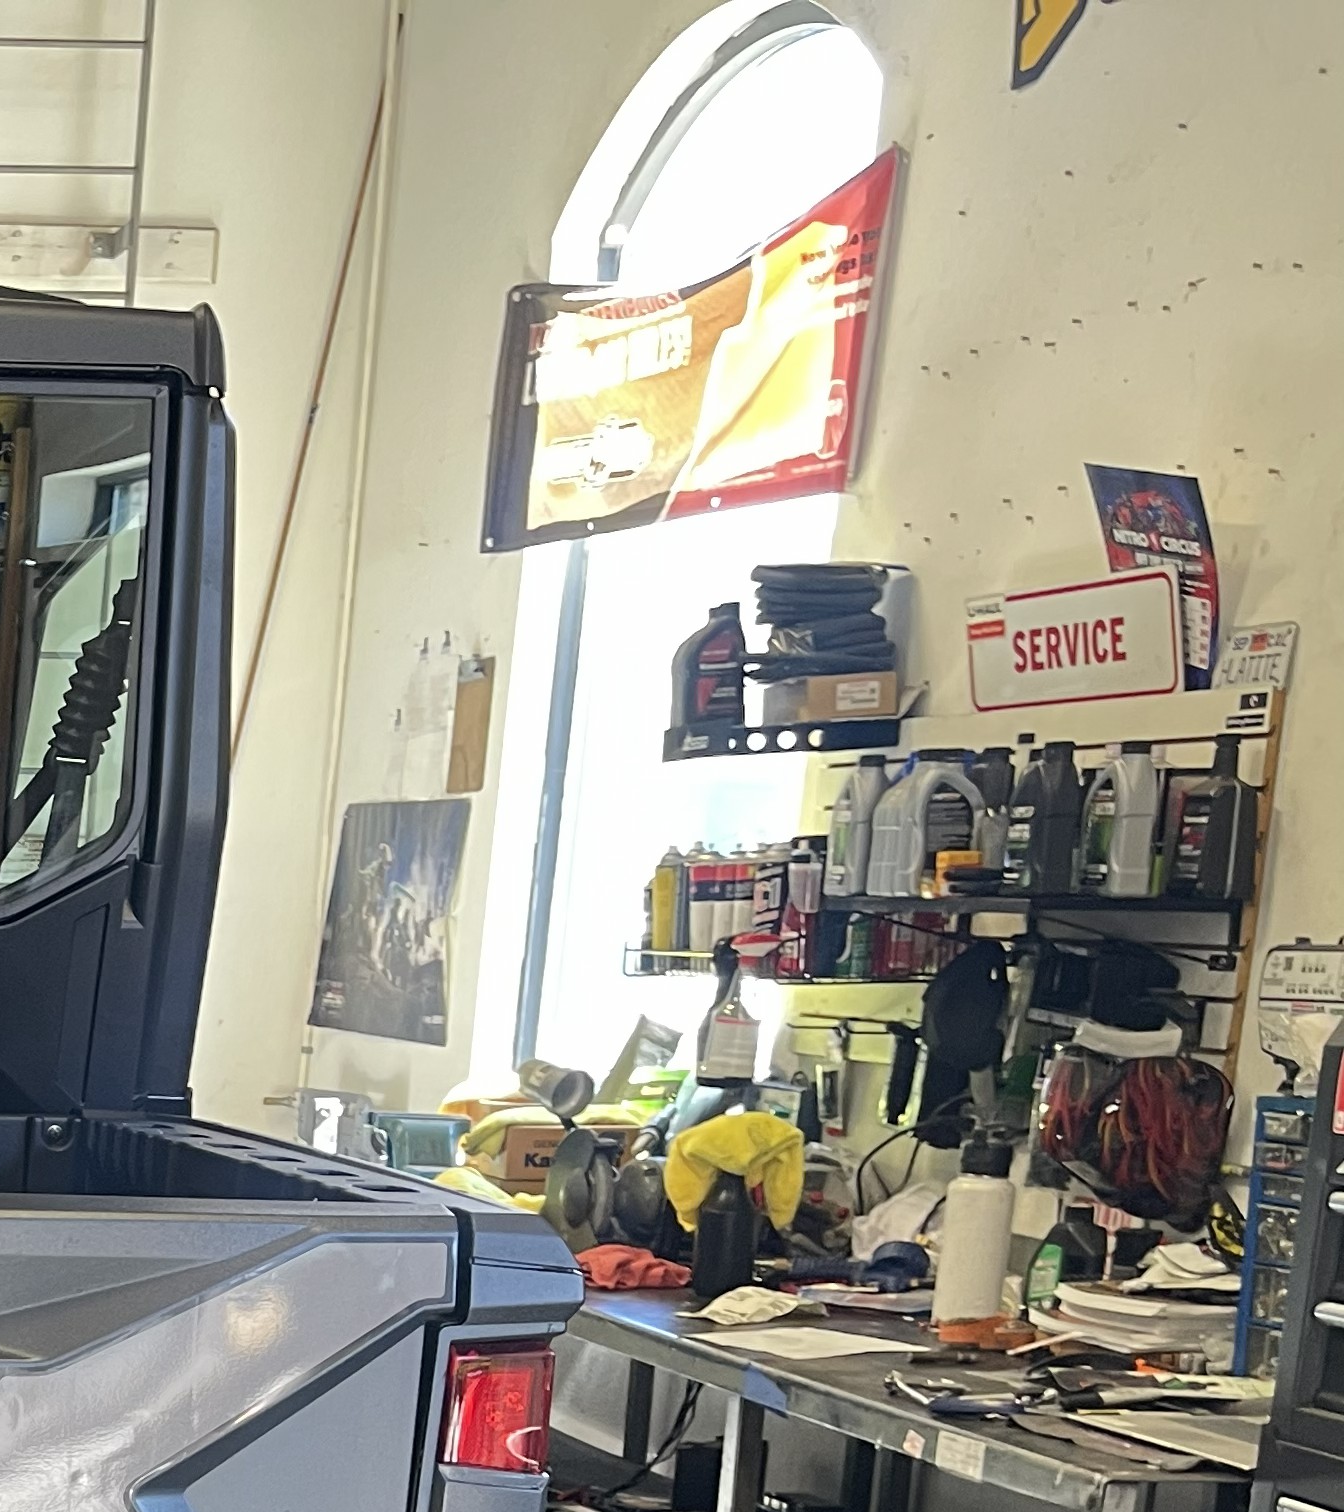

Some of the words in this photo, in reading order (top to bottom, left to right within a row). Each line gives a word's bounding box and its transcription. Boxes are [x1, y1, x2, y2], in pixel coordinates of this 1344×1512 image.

[1112, 528, 1149, 548] NITRO
[1160, 535, 1202, 557] CIRCUS
[1012, 617, 1127, 673] SERVICE
